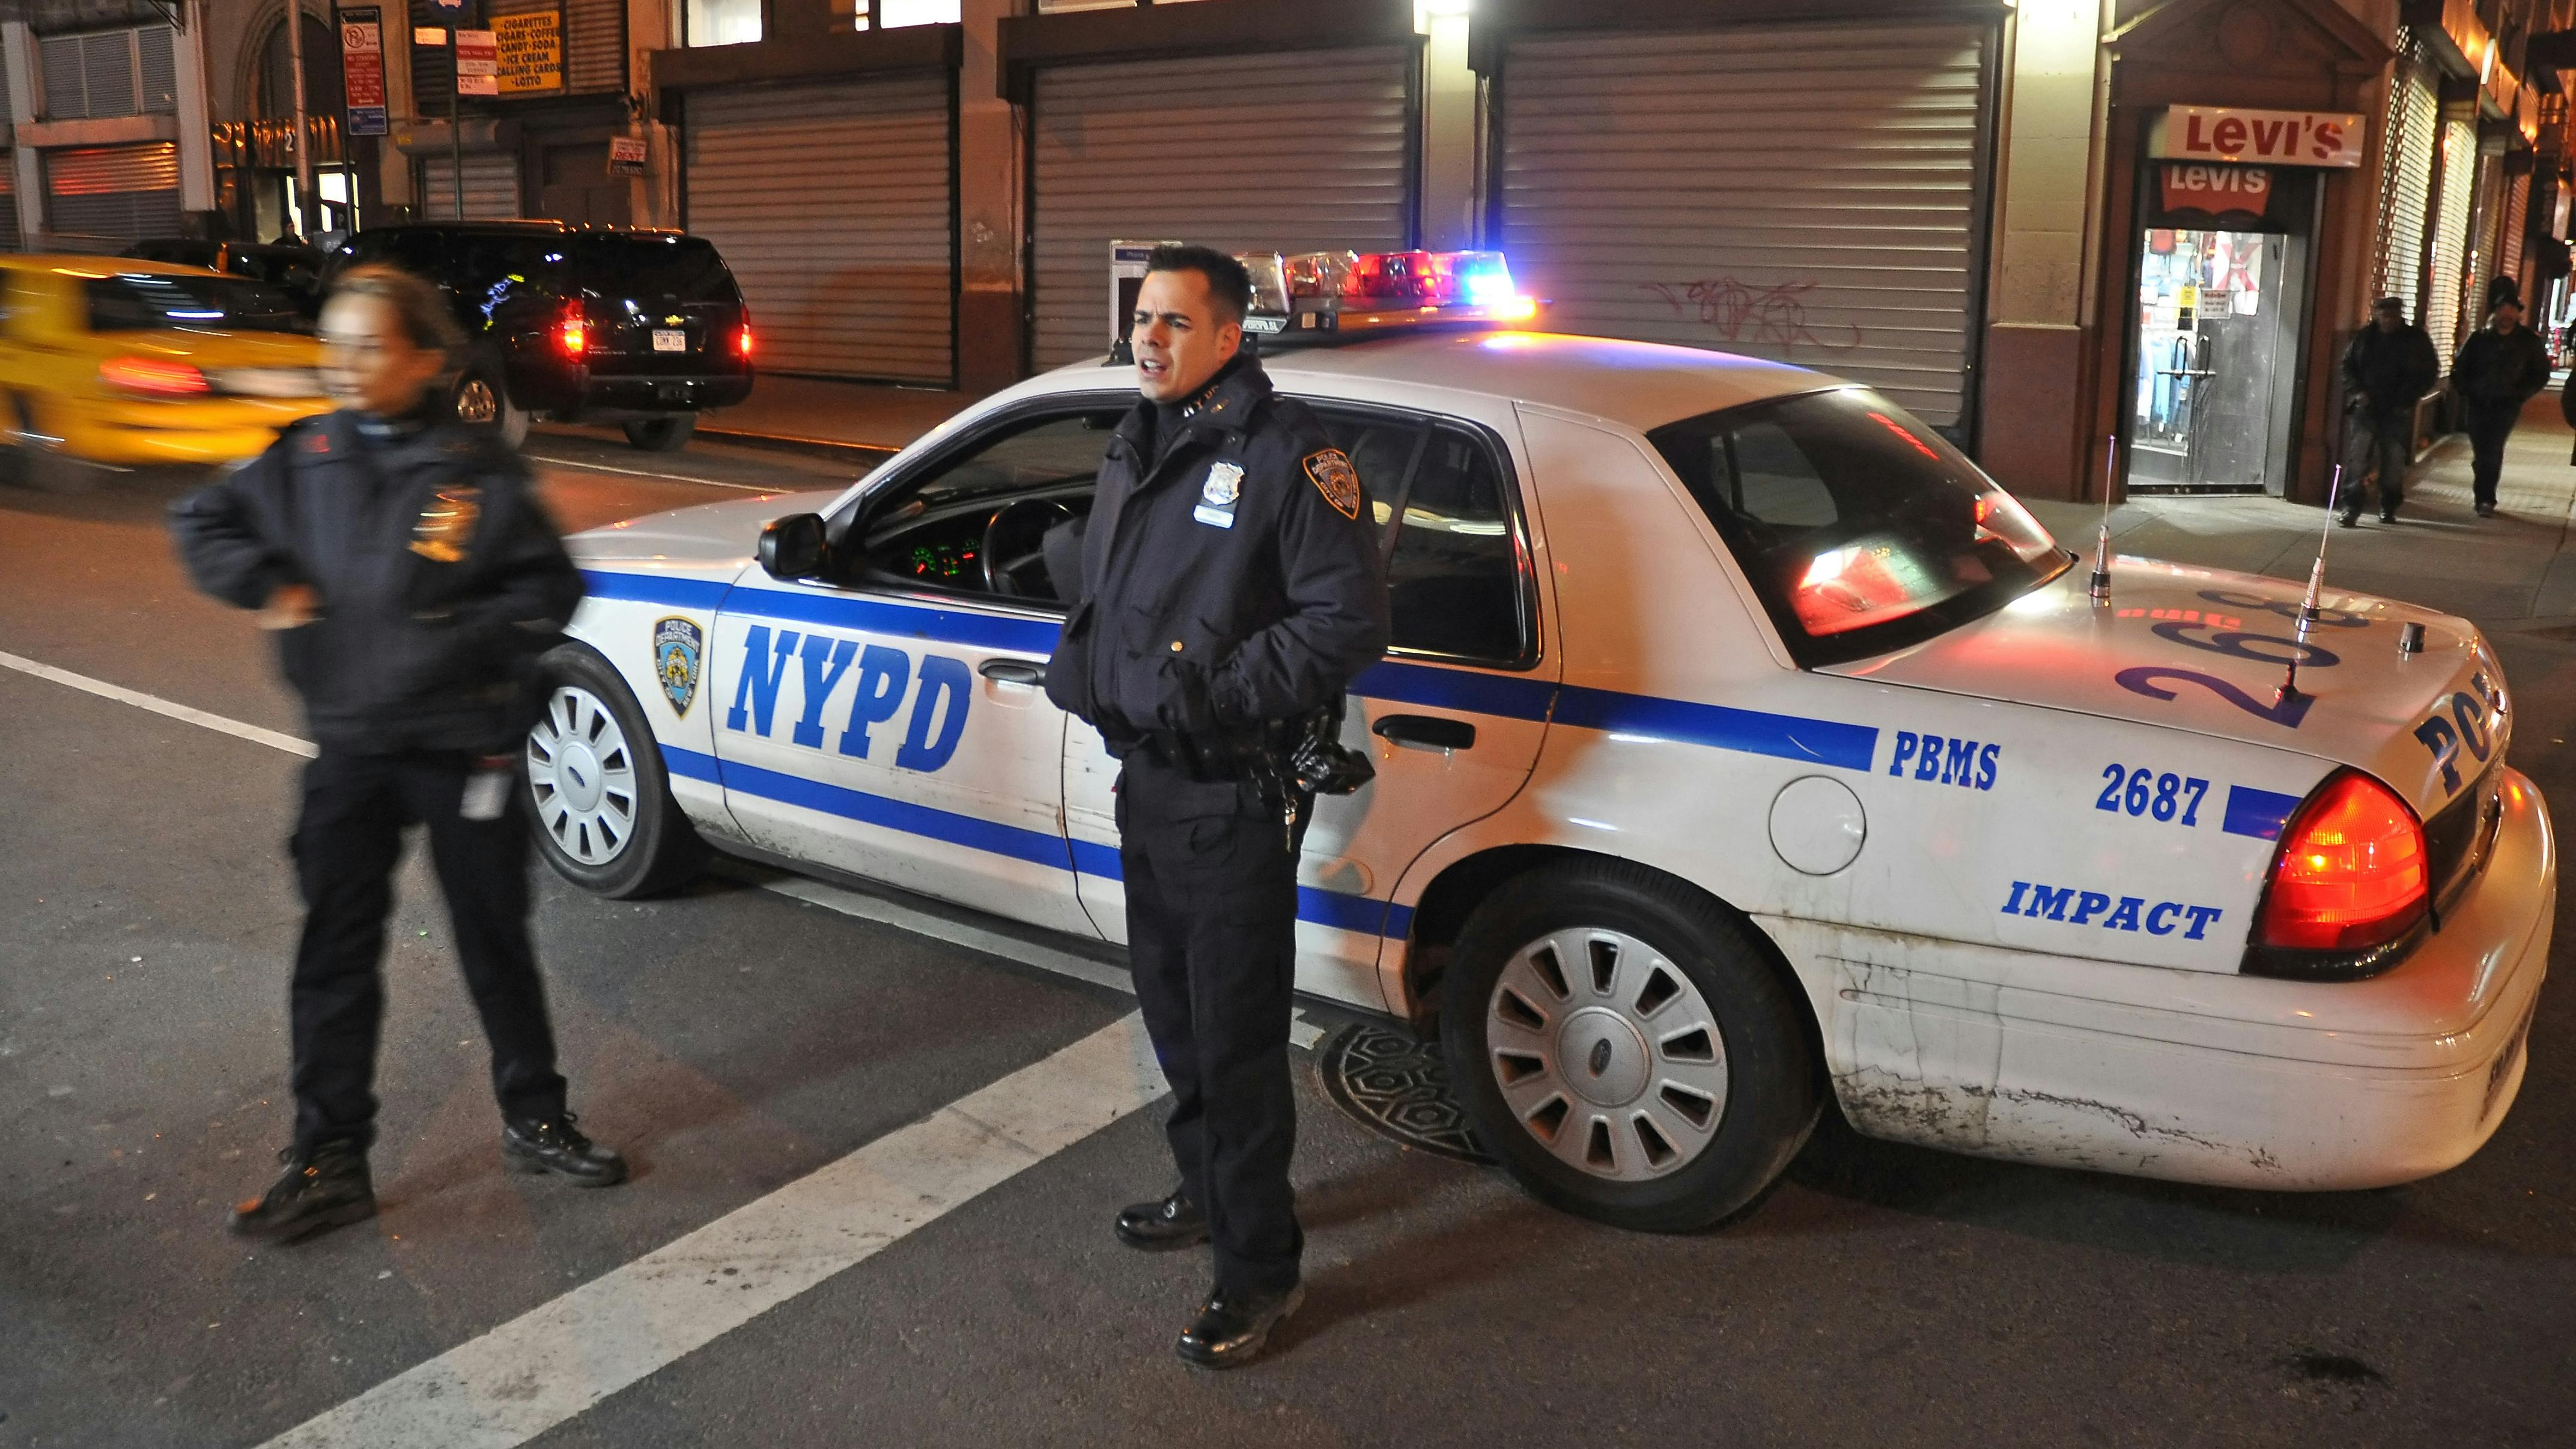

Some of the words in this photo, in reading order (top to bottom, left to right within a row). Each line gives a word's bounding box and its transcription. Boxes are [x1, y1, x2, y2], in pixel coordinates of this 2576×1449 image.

[504, 16, 552, 29] CIGARETTES
[521, 52, 549, 64] CREAM
[655, 631, 700, 654] DEPARTMENT
[664, 619, 693, 636] POLICE
[726, 624, 972, 773] NYPD
[1889, 730, 2001, 791] PBMS
[2095, 763, 2210, 827] 2687
[2000, 881, 2223, 940] IMPACT
